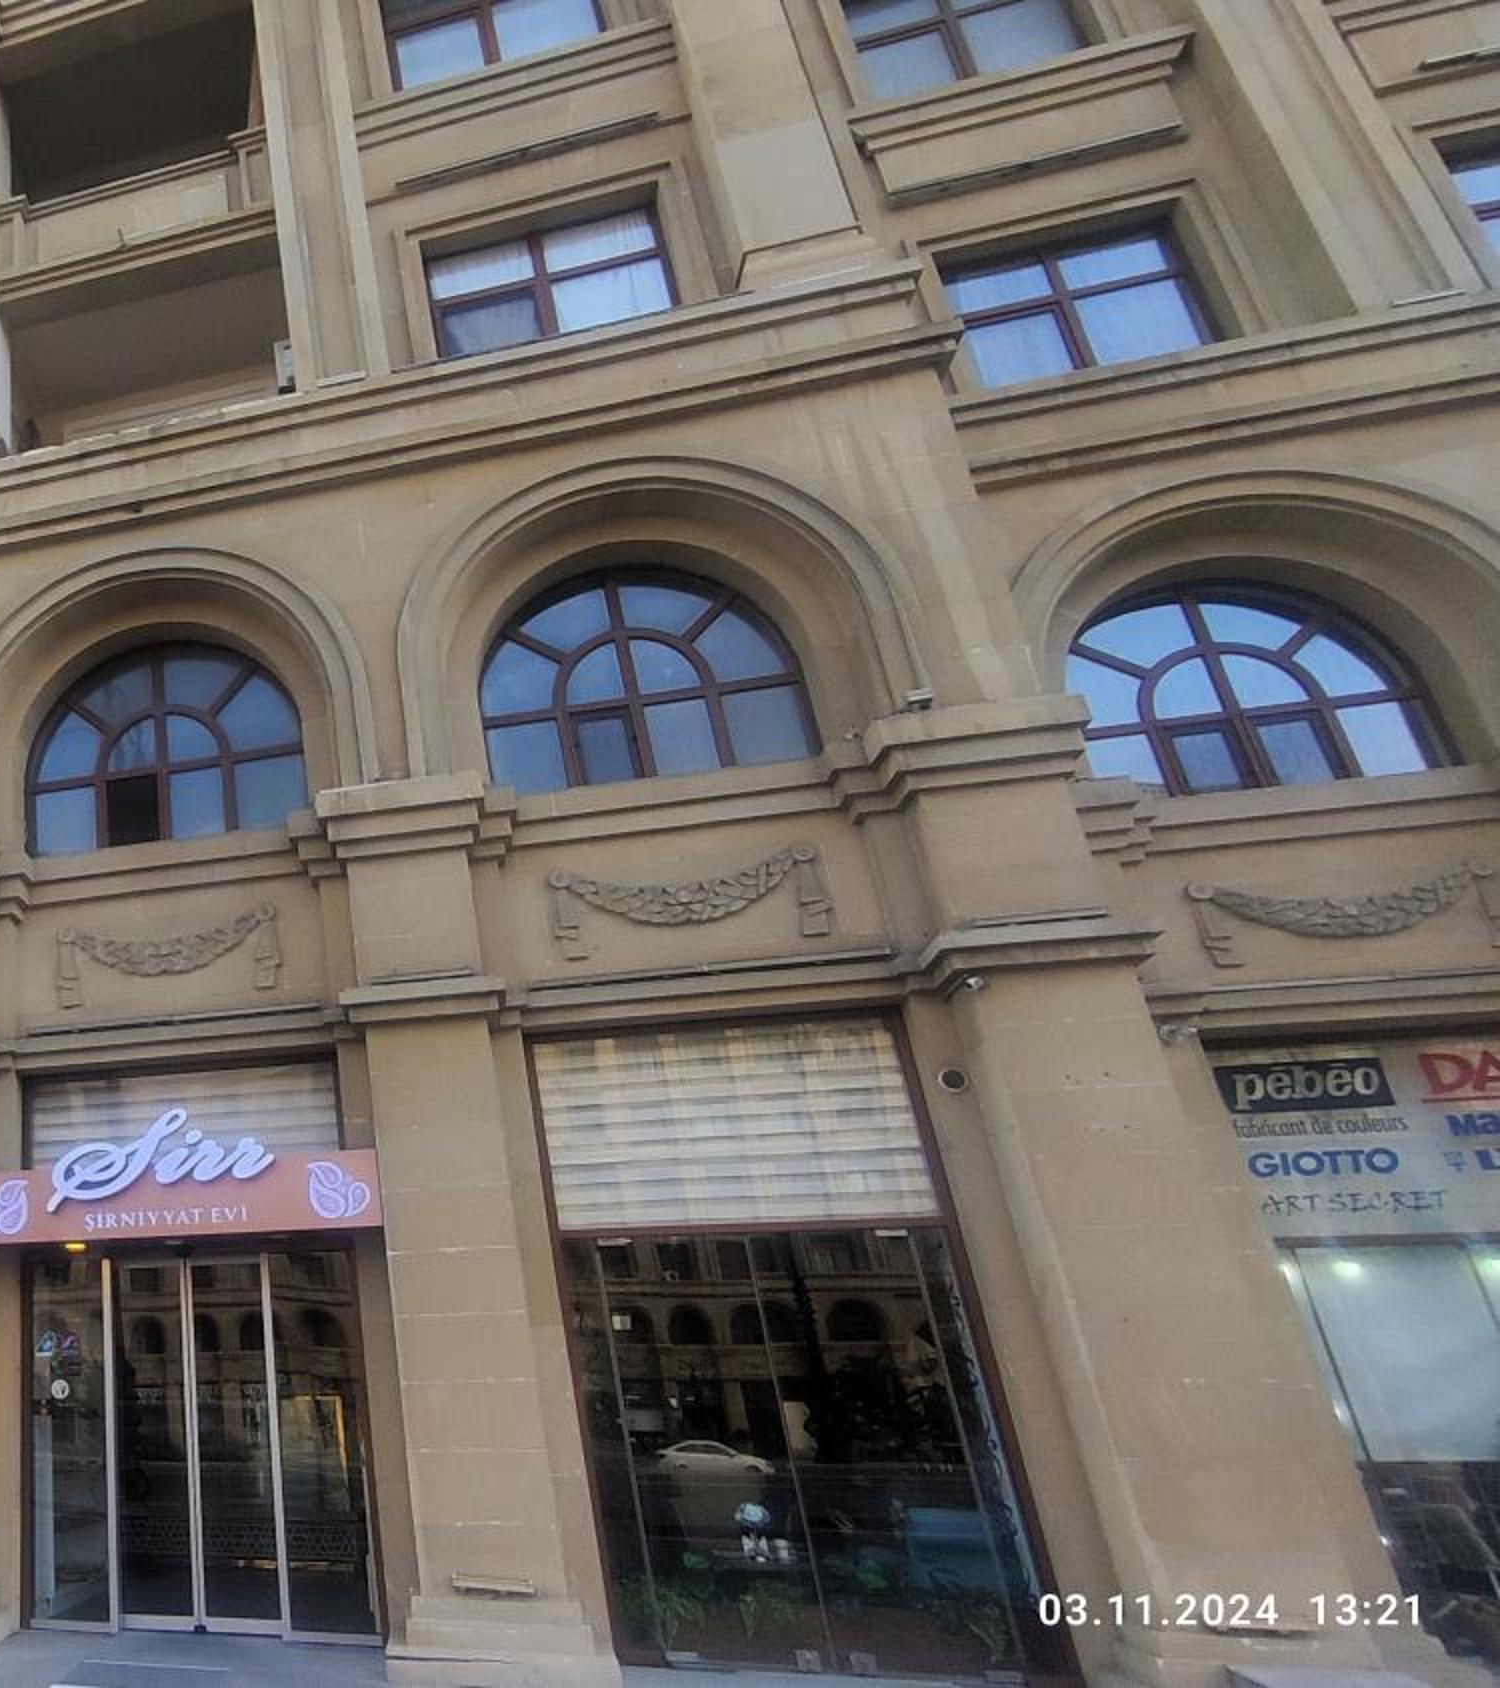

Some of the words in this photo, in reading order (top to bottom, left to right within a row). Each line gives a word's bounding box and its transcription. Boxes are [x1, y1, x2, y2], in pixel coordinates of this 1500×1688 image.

[1232, 1116, 1308, 1138] fabricant
[1311, 1115, 1333, 1135] de
[1336, 1112, 1409, 1134] couleurs
[47, 1107, 274, 1213] Sirr
[1248, 1147, 1399, 1178] GIOTTO
[1262, 1193, 1323, 1216] ART
